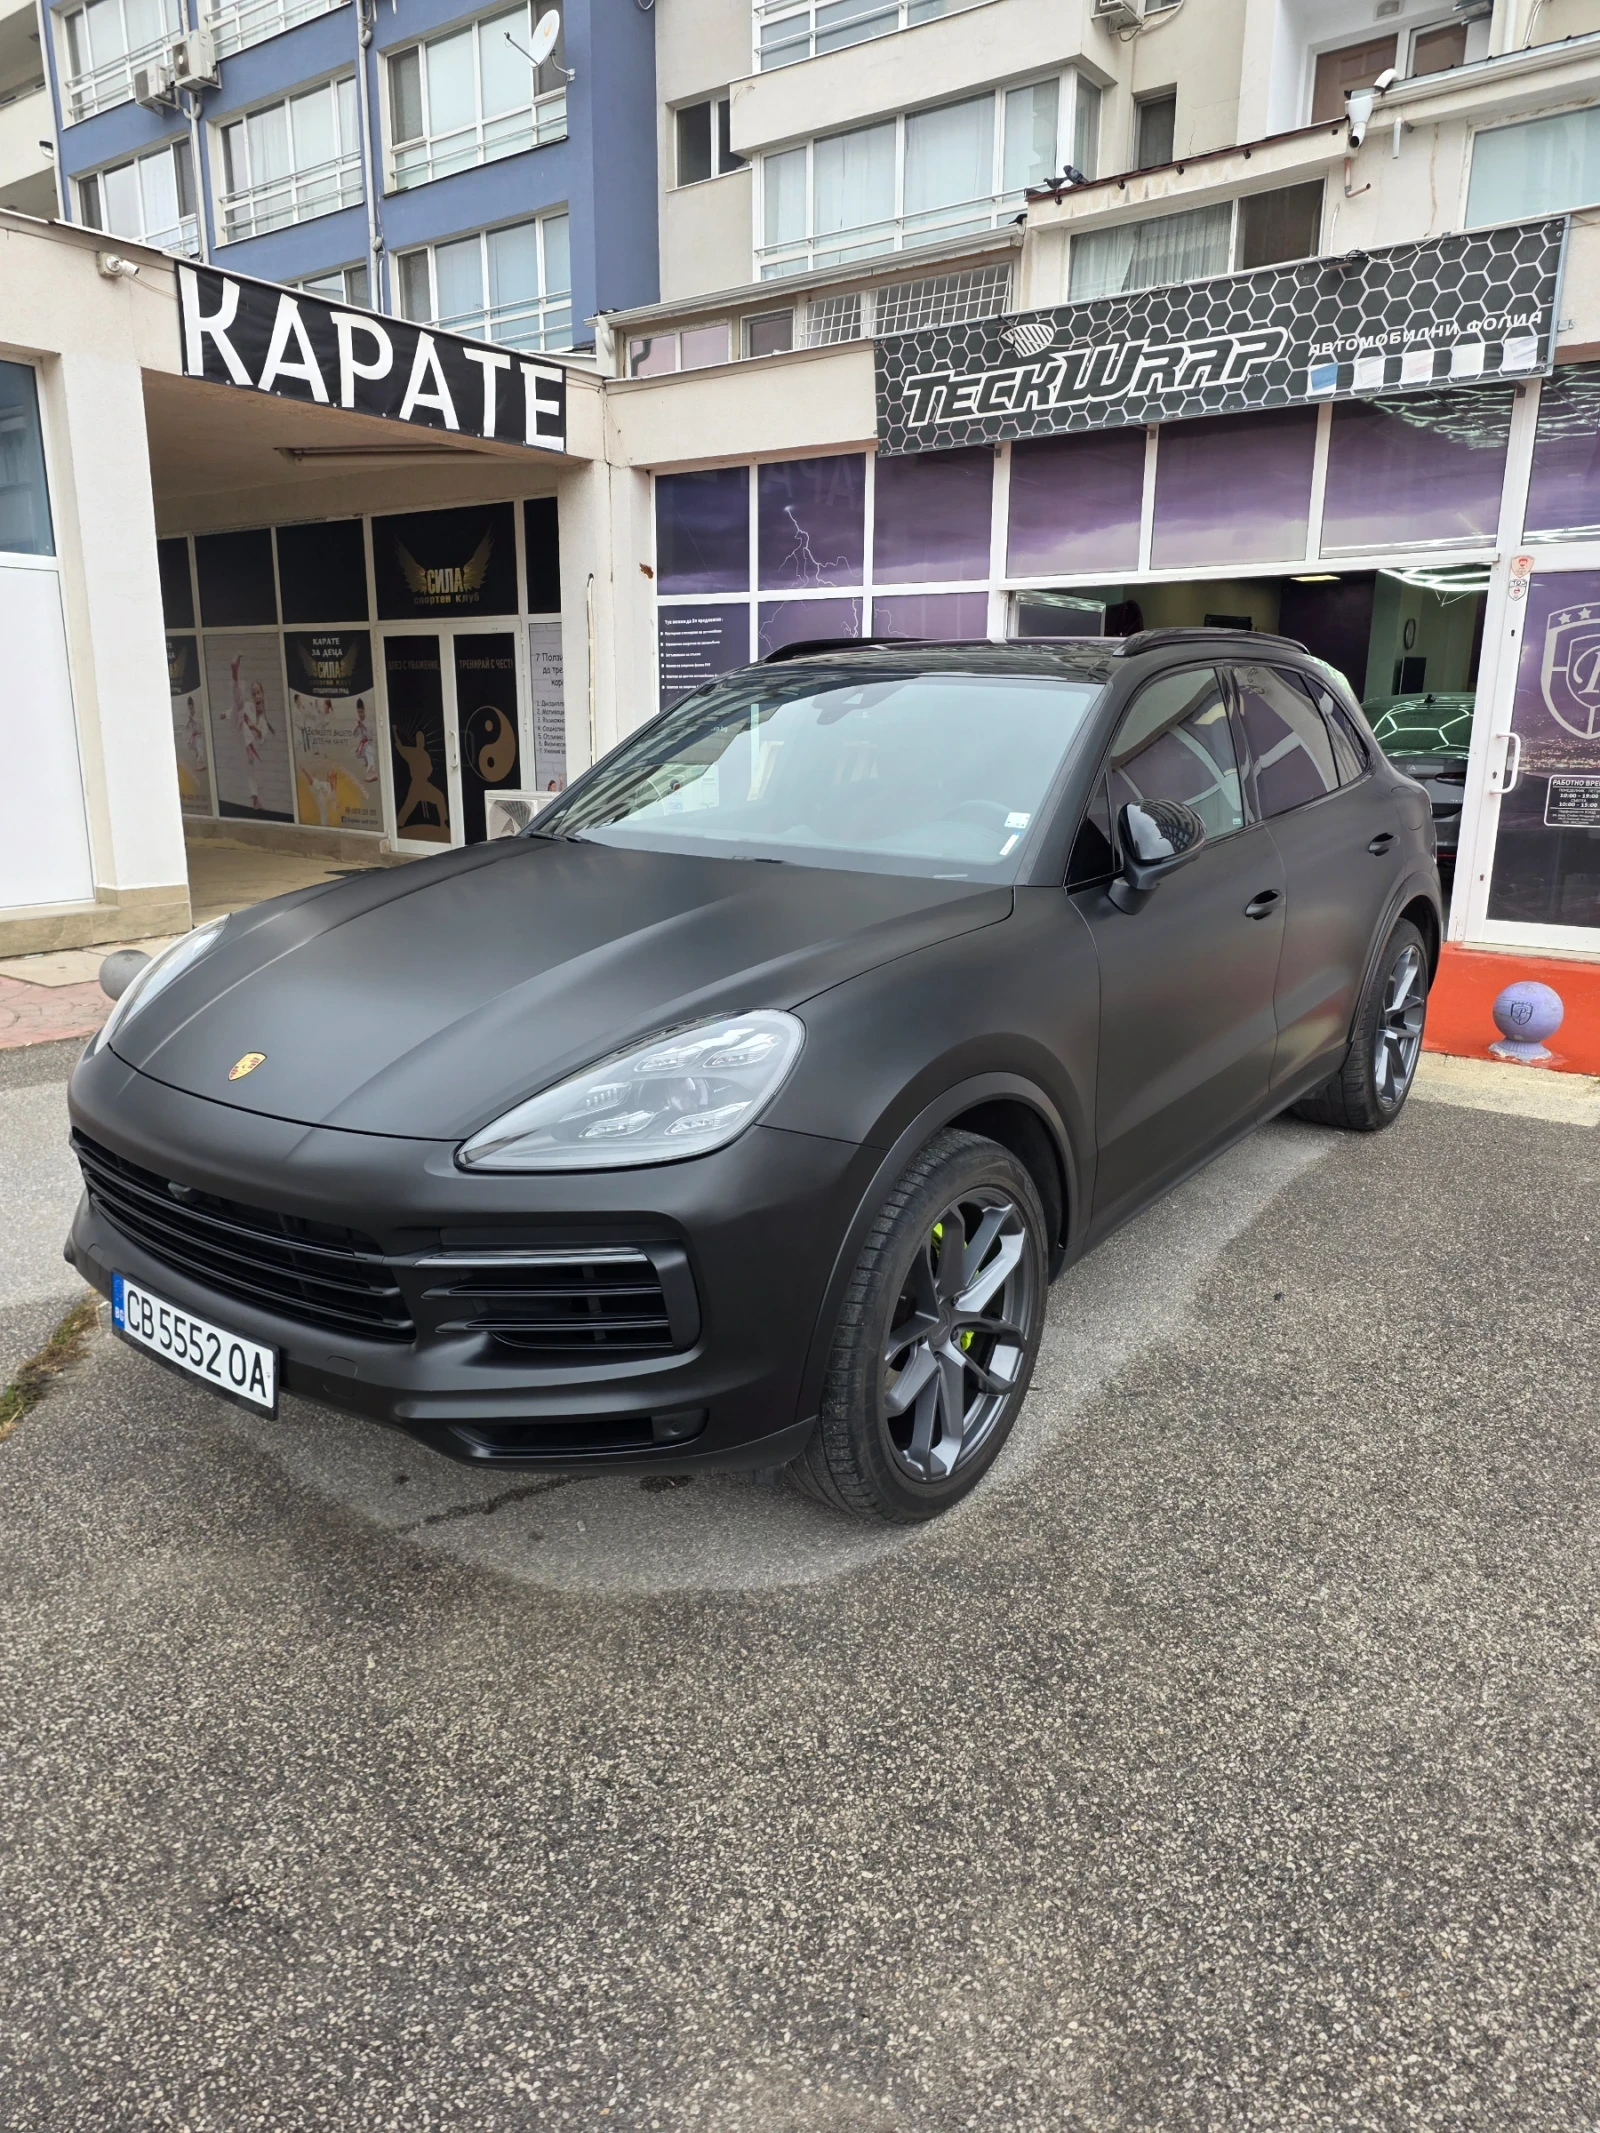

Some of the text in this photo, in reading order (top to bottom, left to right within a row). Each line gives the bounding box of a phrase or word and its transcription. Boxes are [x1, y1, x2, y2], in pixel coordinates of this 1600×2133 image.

[1308, 311, 1542, 356] АВТОМОБИЛНИ ФОЛИА
[178, 264, 565, 451] КАРАТЕ
[903, 326, 1288, 427] TECKWRAP
[426, 568, 464, 594] СИЛА
[414, 592, 480, 605] спортен клуб
[322, 648, 342, 657] ДЕЦА
[536, 653, 540, 662] 7
[317, 661, 341, 679] СИЛА
[459, 658, 513, 669] ТРЕНИРАЙ С ЧЕСТ!
[114, 1306, 124, 1321] BG
